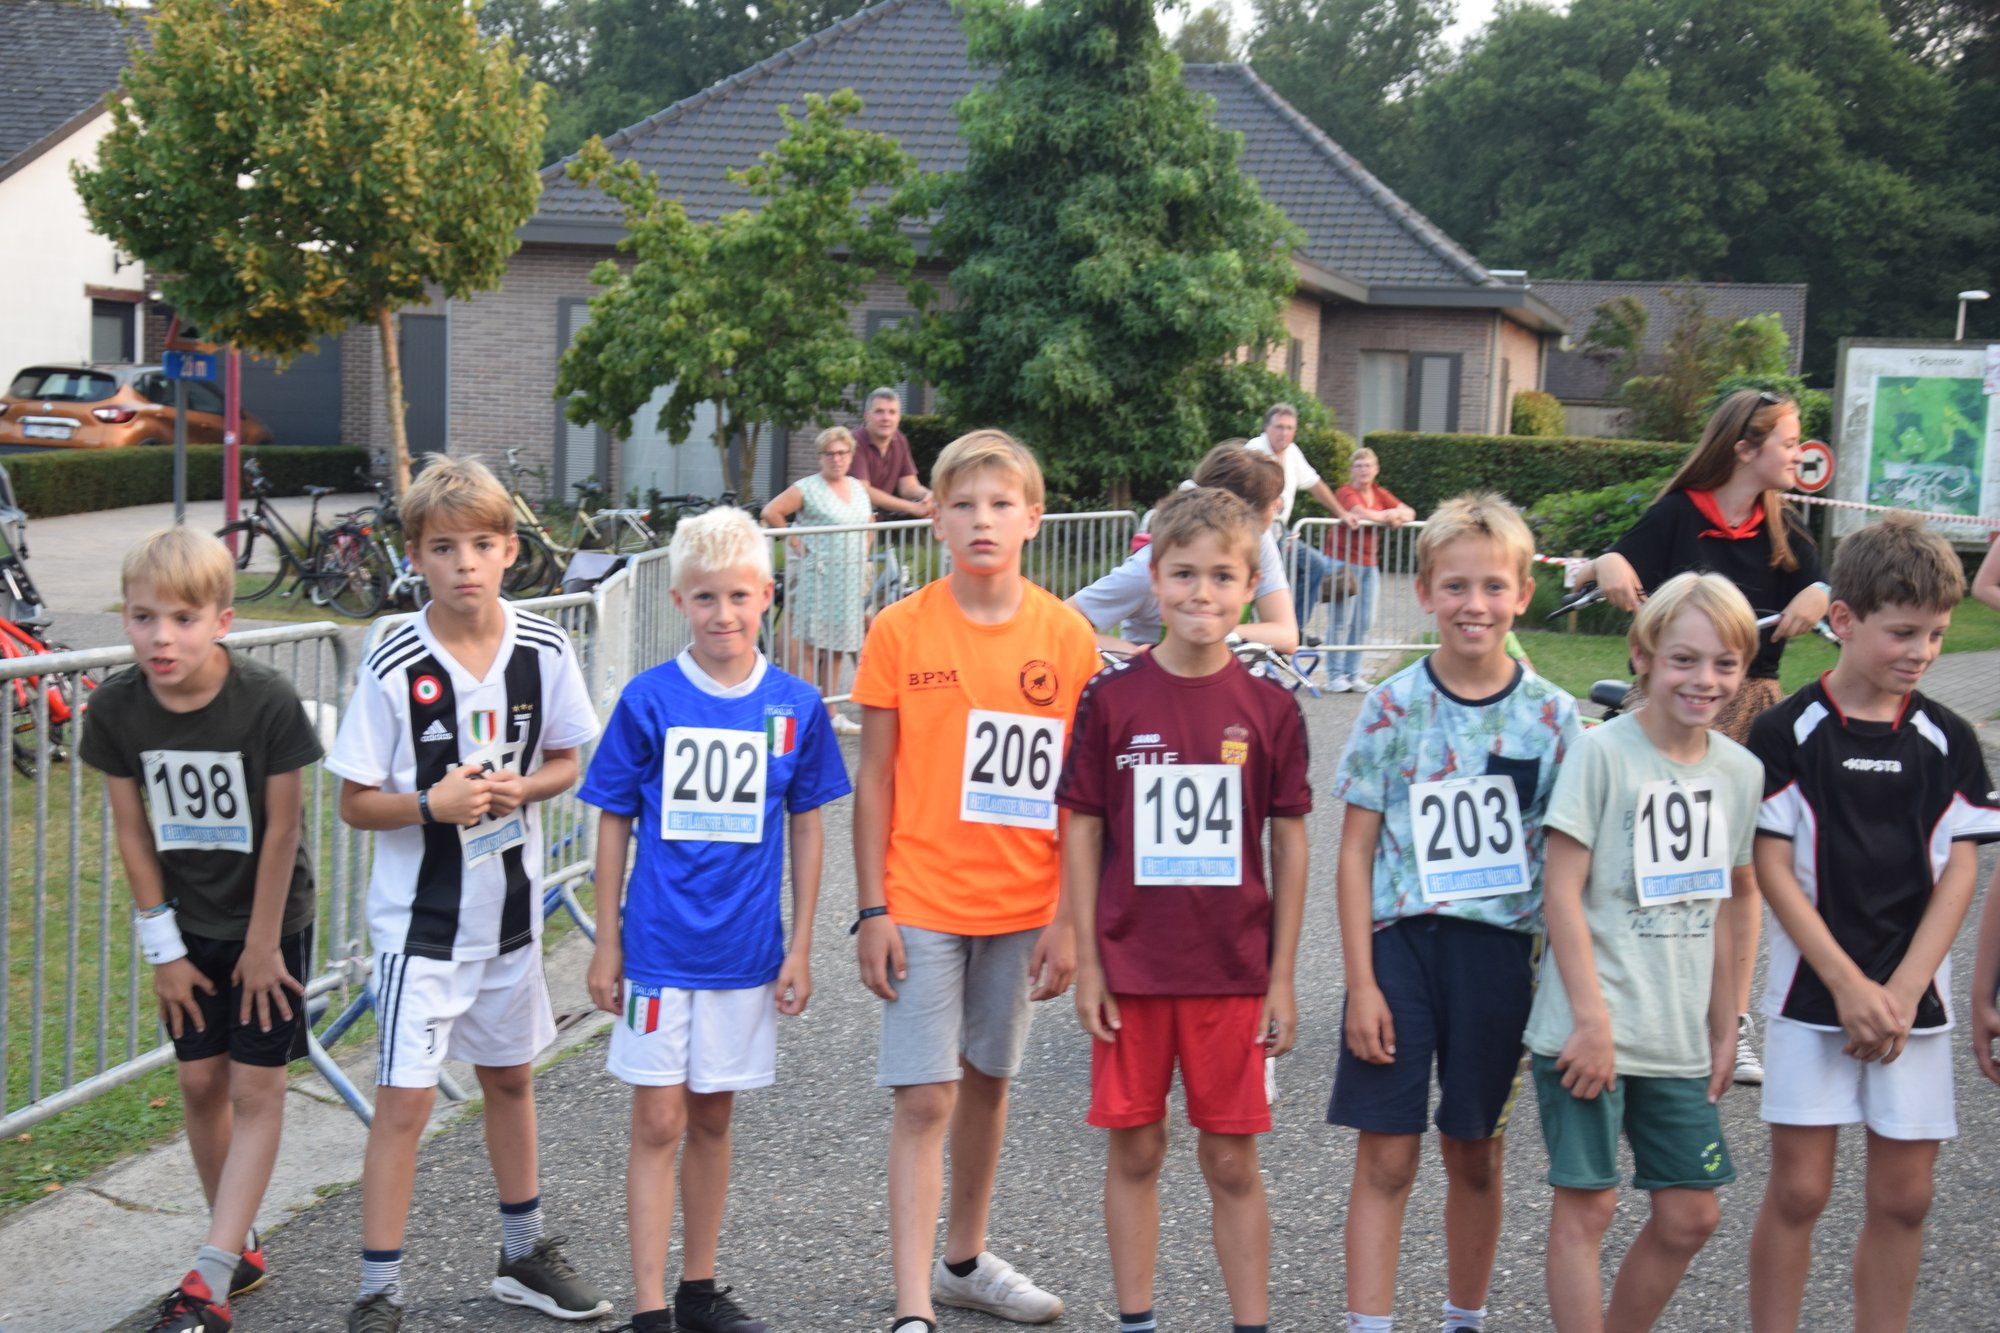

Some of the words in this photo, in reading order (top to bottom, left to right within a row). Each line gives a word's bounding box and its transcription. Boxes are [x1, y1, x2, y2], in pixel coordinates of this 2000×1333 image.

[908, 670, 958, 686] BPM
[673, 738, 758, 802] 202
[971, 721, 1052, 790] 206
[155, 763, 237, 819] 198
[1146, 777, 1232, 845] 194
[1421, 787, 1513, 862] 203
[1642, 790, 1712, 863] 197
